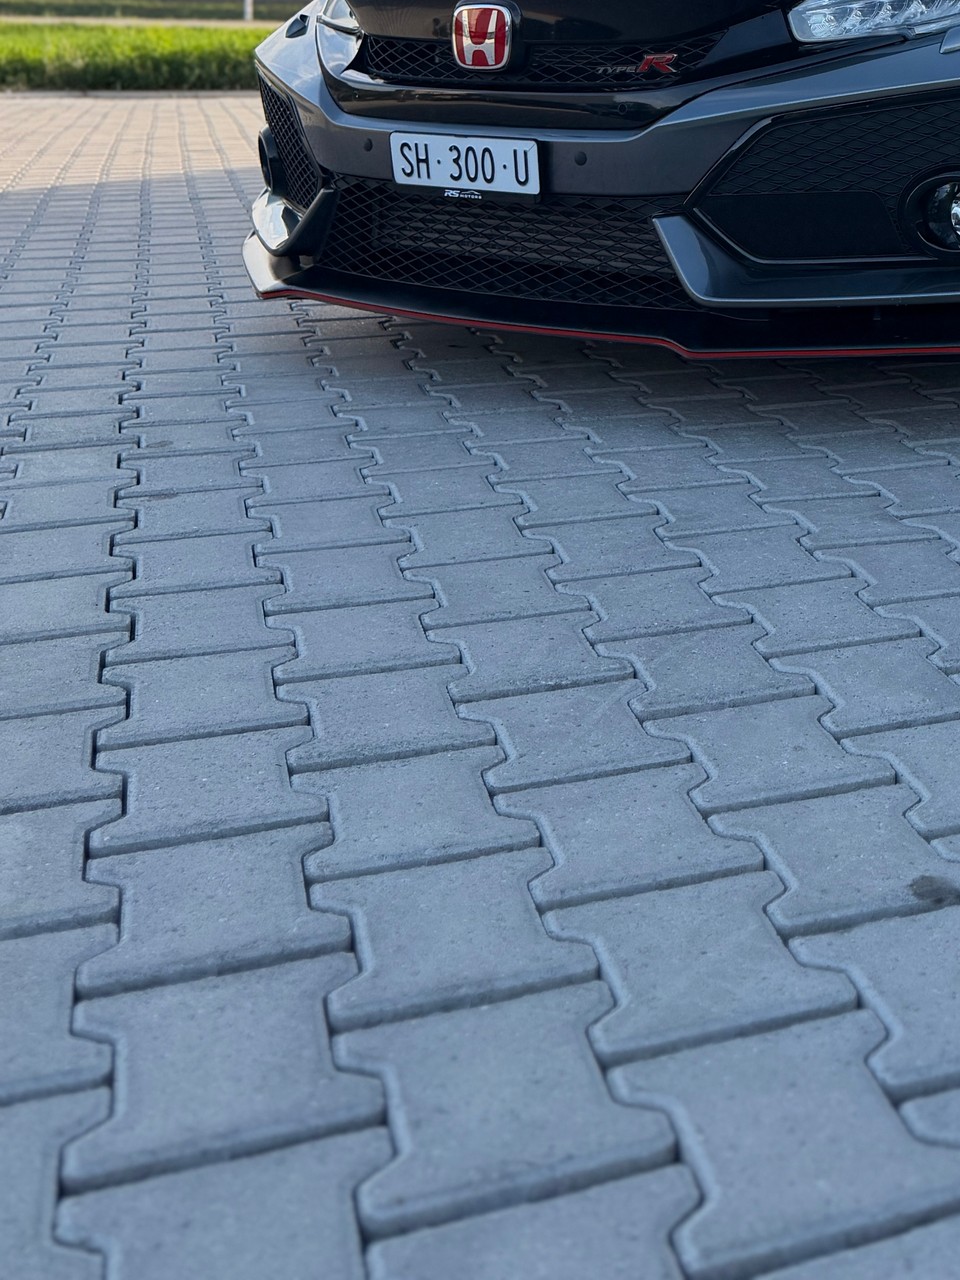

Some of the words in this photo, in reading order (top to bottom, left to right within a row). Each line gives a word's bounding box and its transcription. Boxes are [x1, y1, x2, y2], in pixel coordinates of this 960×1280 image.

[596, 66, 637, 74] TYPE
[636, 53, 678, 73] R
[444, 189, 460, 198] RS
